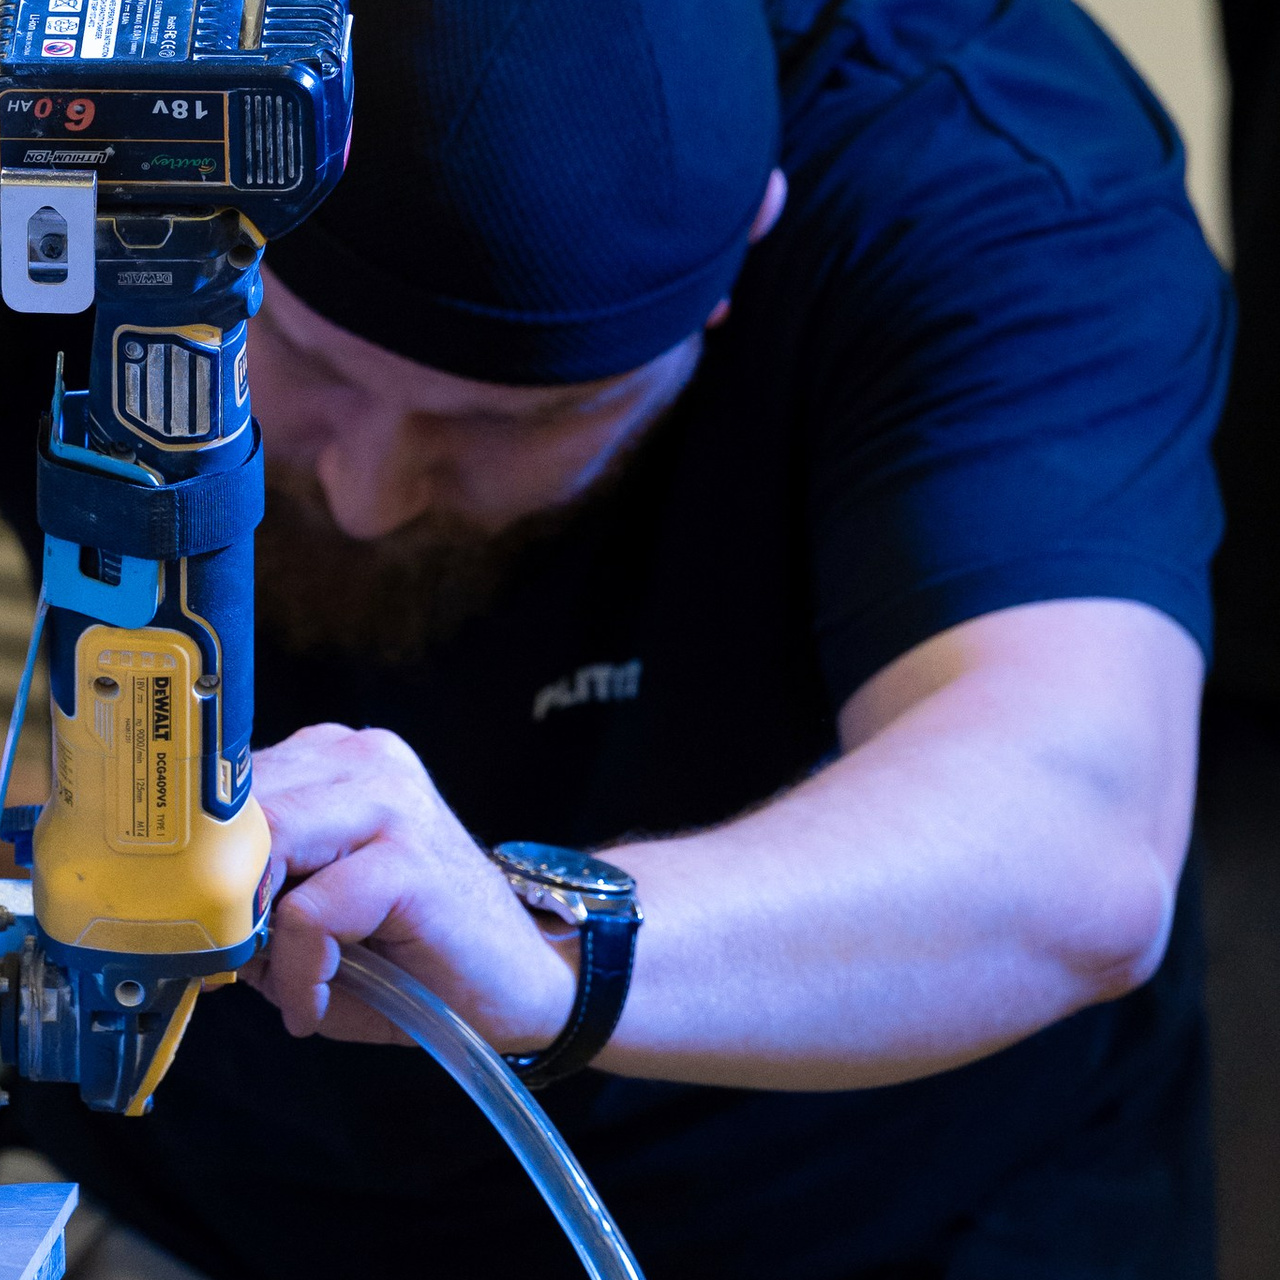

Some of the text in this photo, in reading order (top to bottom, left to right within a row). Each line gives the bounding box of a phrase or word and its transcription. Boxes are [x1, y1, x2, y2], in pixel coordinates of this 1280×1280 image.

[23, 149, 110, 164] LITHIUM-ION
[137, 677, 145, 692] 18V
[156, 752, 167, 808] DCG409VS
[136, 778, 145, 803] 125mm
[157, 814, 165, 831] TYPE
